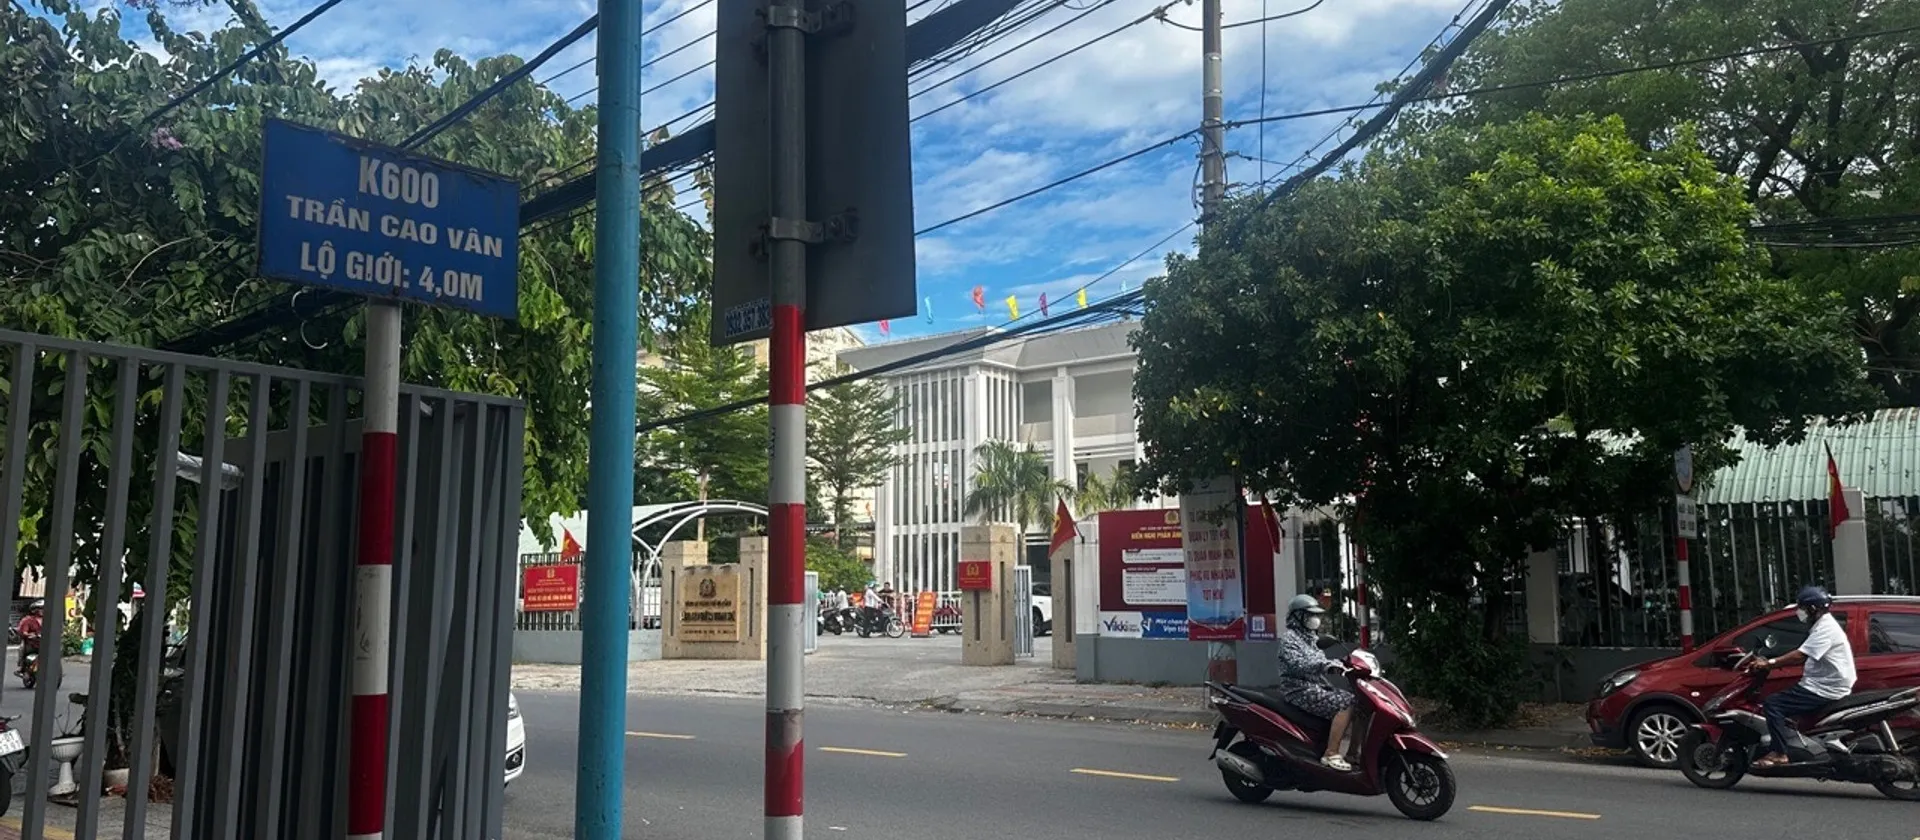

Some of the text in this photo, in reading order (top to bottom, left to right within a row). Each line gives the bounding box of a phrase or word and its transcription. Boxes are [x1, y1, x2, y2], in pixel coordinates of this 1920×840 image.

[358, 155, 440, 209] K600
[286, 195, 502, 258] TRẦN CAO VÂN
[300, 240, 336, 280] LỘ
[346, 251, 409, 289] GIỚI:
